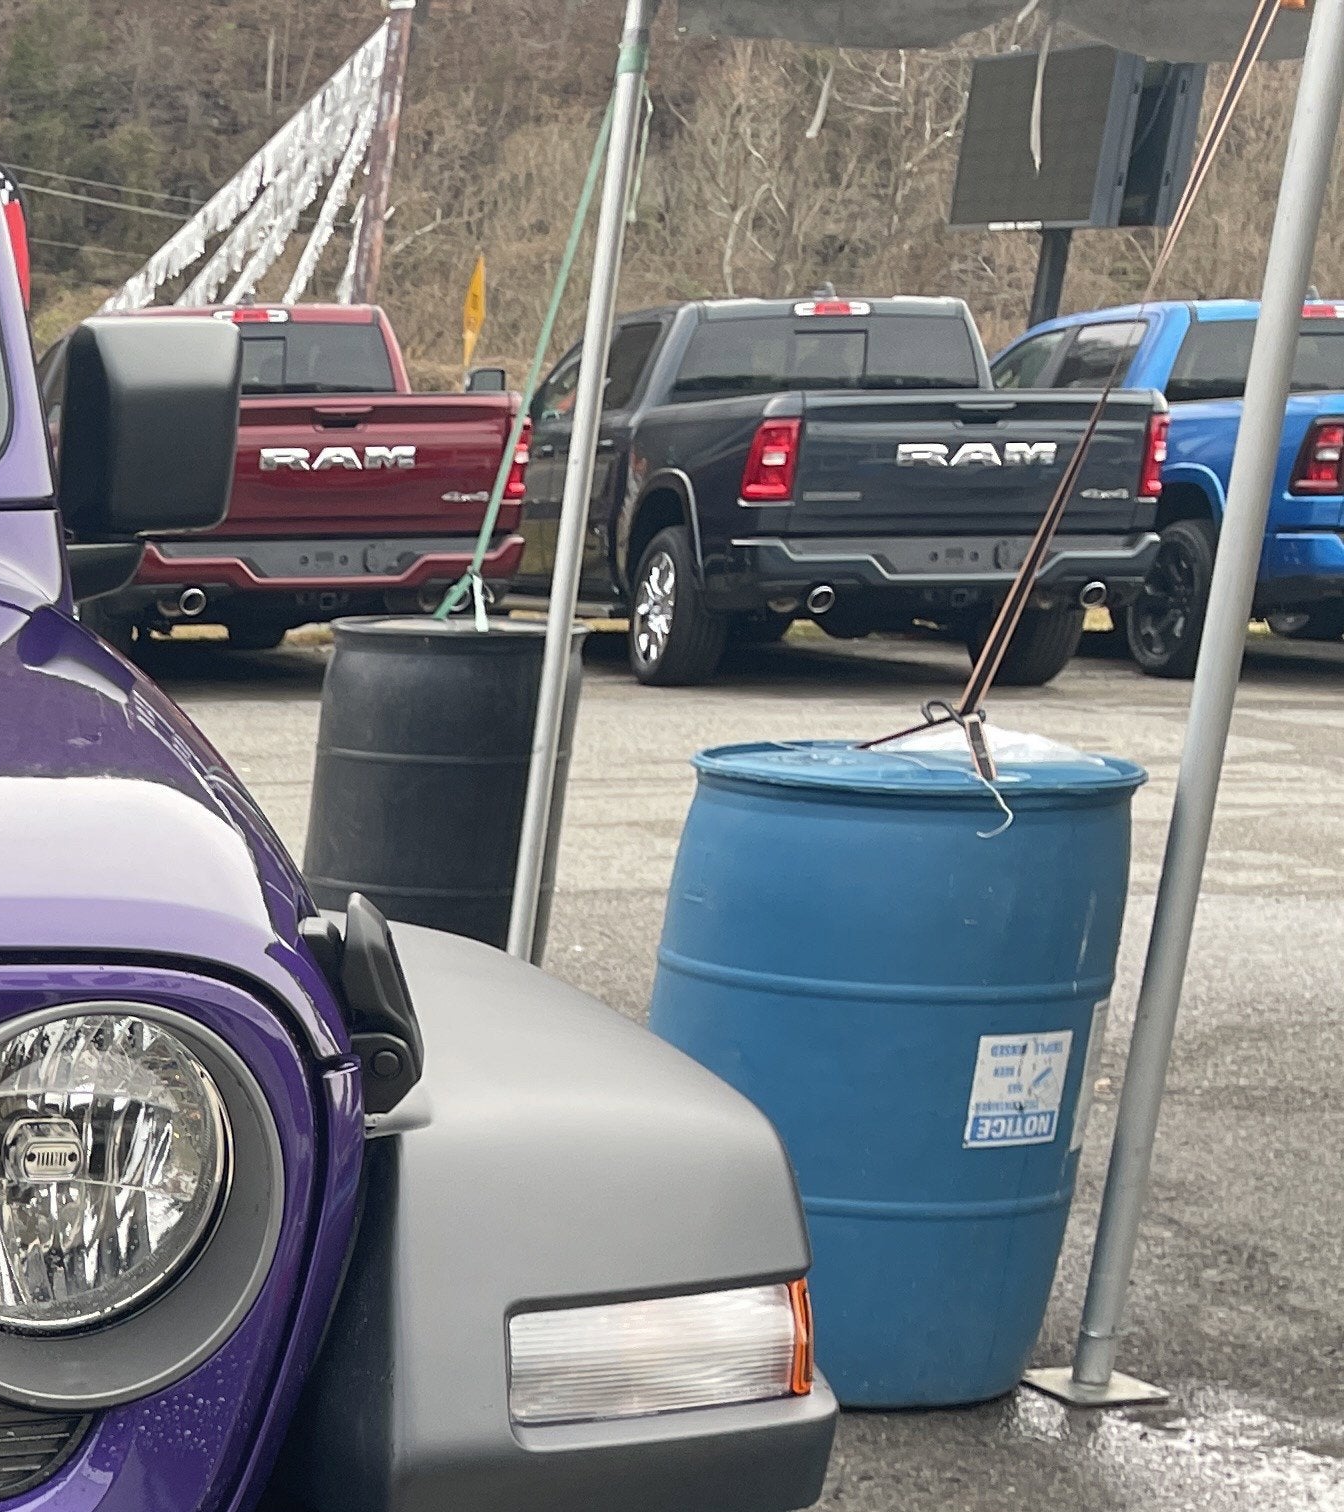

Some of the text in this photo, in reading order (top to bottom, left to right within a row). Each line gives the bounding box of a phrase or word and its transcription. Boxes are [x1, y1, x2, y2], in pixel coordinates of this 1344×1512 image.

[259, 445, 417, 471] RAM
[895, 441, 1058, 467] RAM
[975, 1113, 1051, 1140] NOTICE
